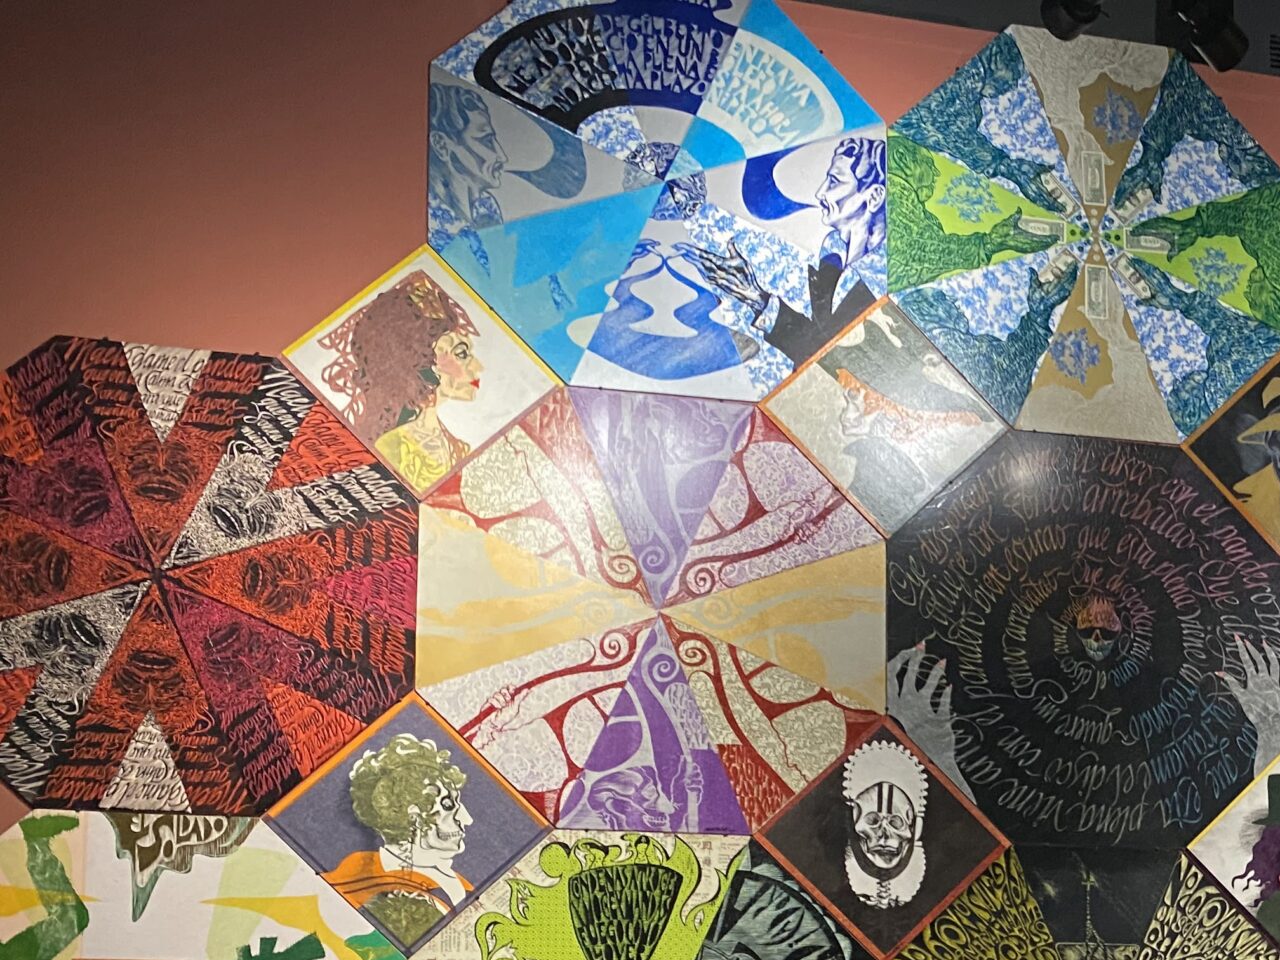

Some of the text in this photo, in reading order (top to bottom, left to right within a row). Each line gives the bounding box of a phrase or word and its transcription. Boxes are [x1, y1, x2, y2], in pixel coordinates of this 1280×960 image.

[1101, 449, 1167, 486] disco
[1158, 473, 1198, 514] con
[1194, 496, 1229, 528] el
[1073, 526, 1110, 553] que
[1207, 516, 1279, 605] pandero
[964, 561, 1012, 614] bien
[1147, 558, 1197, 610] plena
[1193, 549, 1240, 609] Oye
[1003, 569, 1060, 640] arrebatao
[941, 607, 1003, 705] pandero
[1176, 604, 1208, 664] viene
[1056, 654, 1092, 698] disco
[1087, 670, 1107, 700] el
[963, 702, 1004, 731] el
[1026, 695, 1061, 726] un
[1052, 708, 1116, 746] quiere
[1126, 663, 1201, 750] arrasando
[992, 725, 1042, 777] con
[1040, 752, 1103, 797] disco
[988, 771, 1069, 831] viene
[1109, 763, 1137, 802] el
[134, 813, 228, 863] SOLDADO
[1066, 793, 1157, 846] plena
